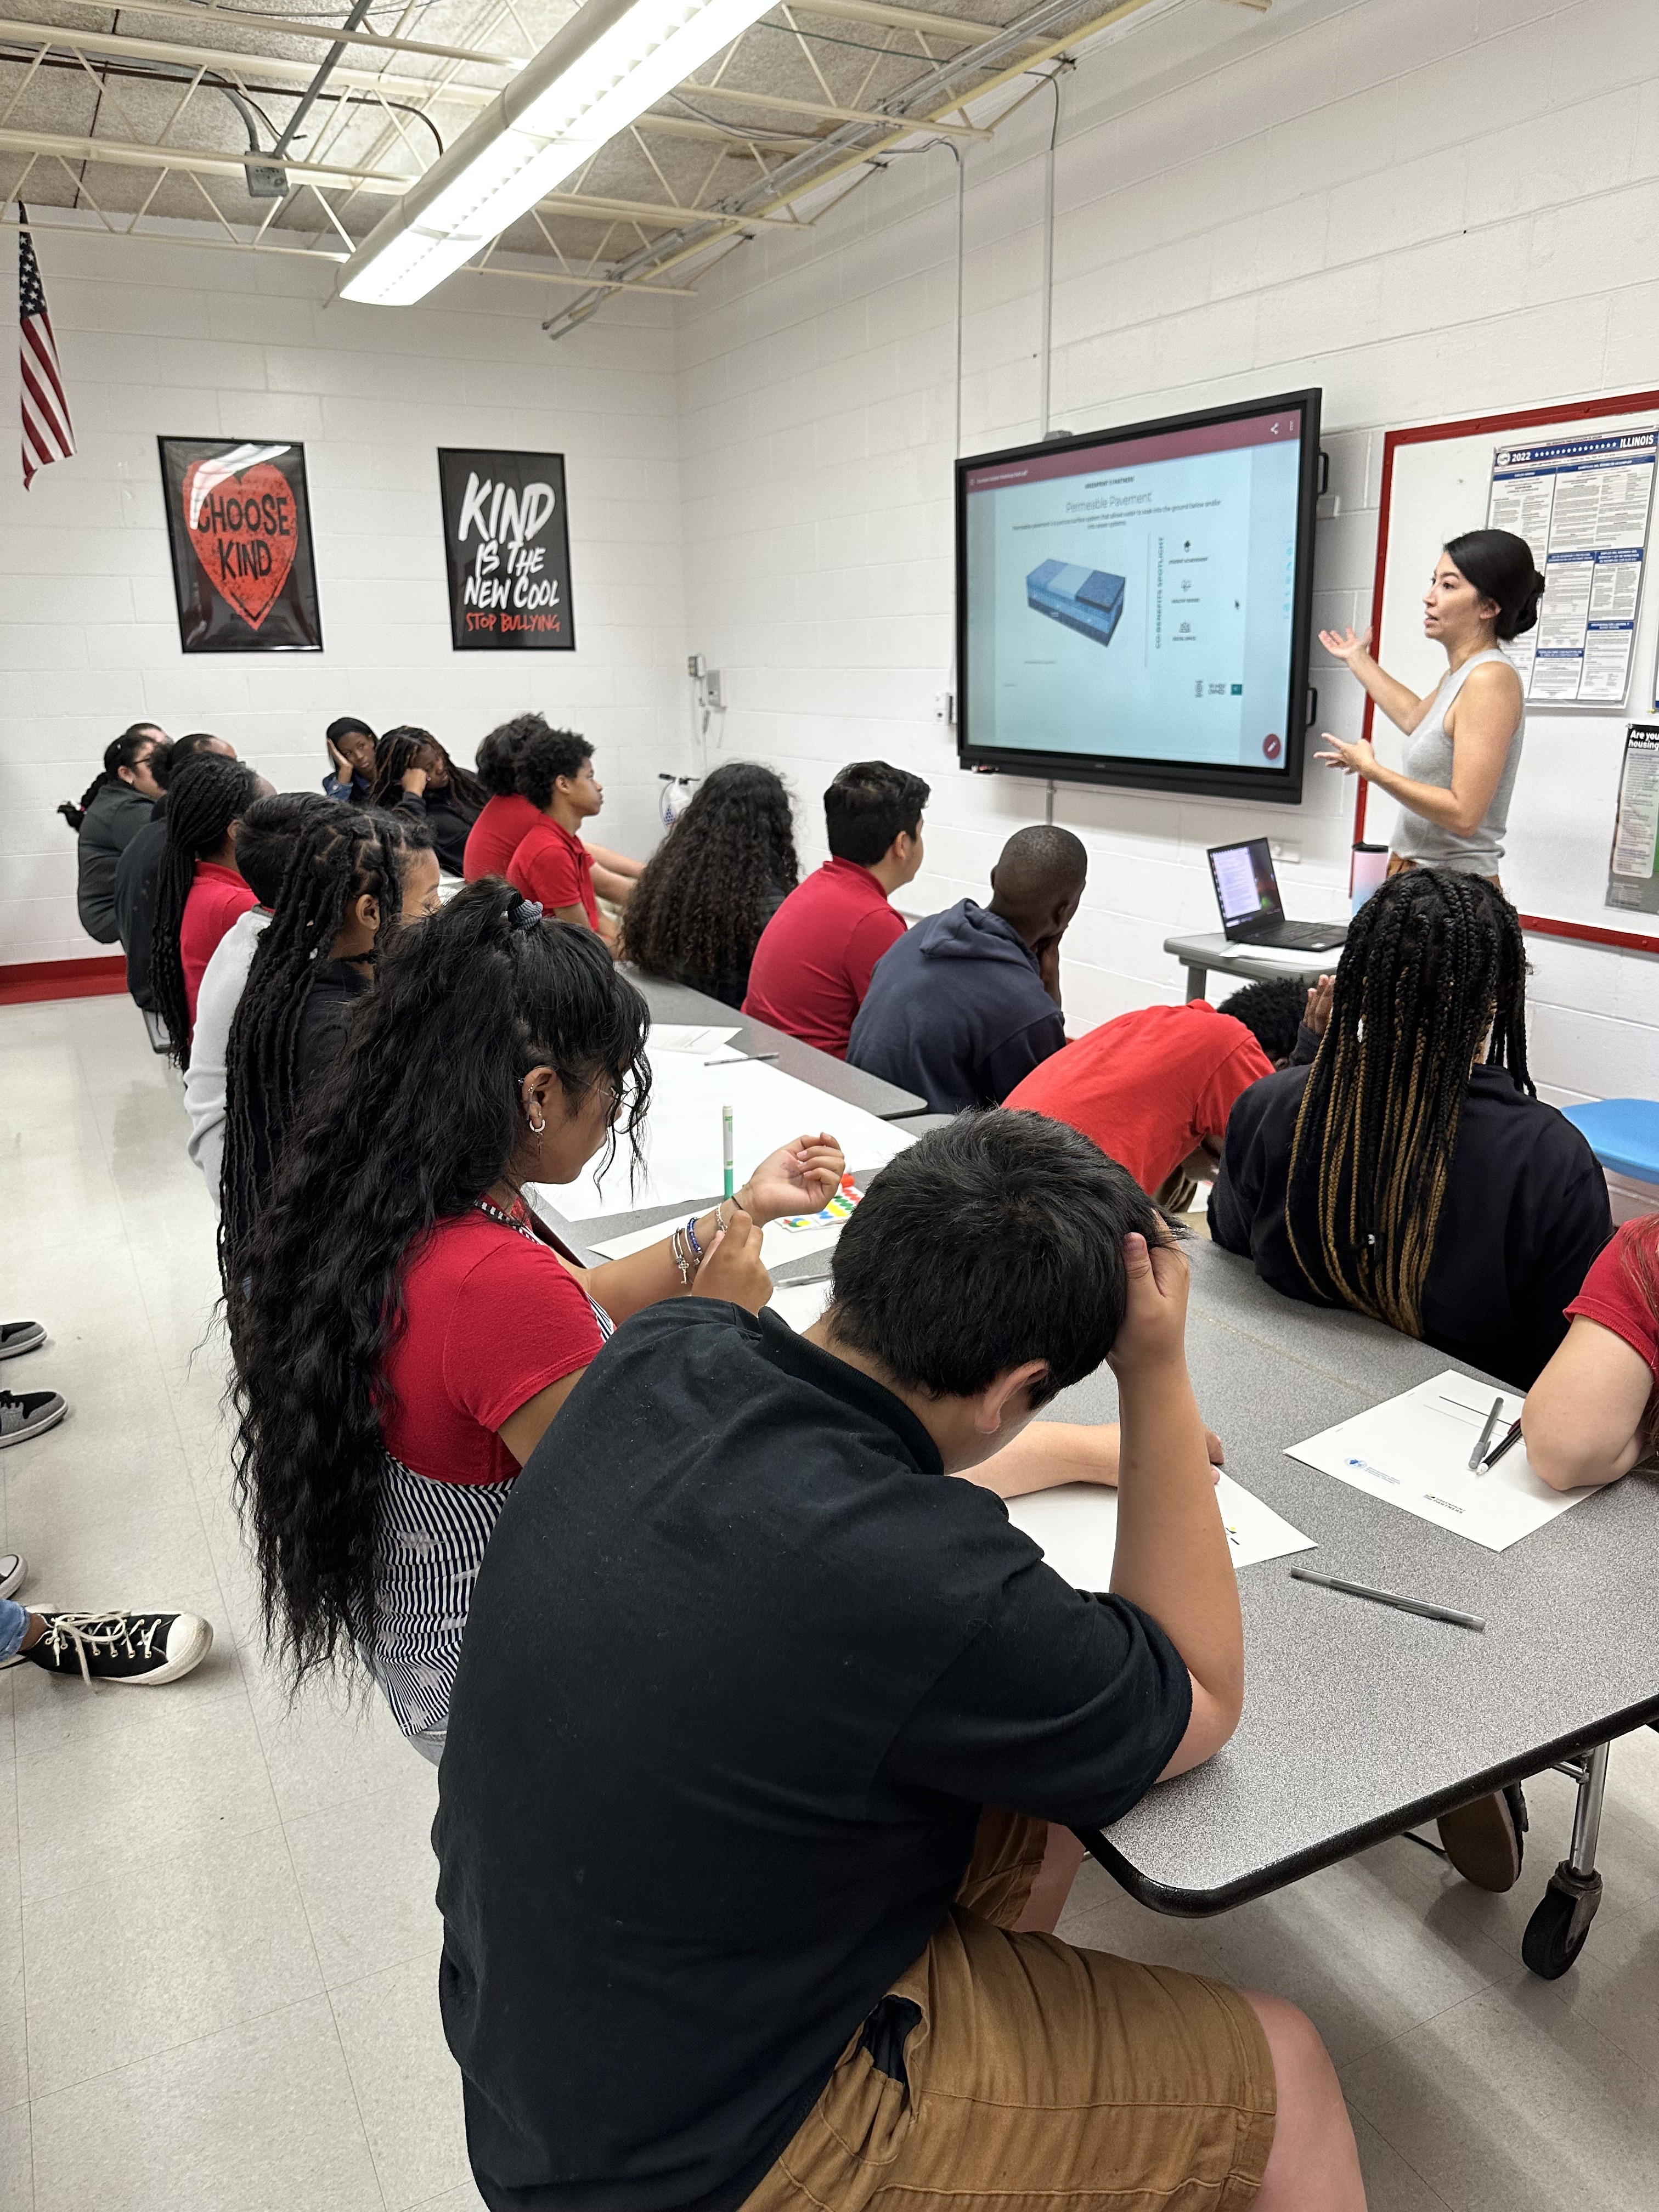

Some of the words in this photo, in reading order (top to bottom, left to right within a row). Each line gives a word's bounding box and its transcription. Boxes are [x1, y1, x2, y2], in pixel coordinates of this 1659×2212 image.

[1511, 452, 1532, 462] 2022
[1620, 435, 1654, 449] ILLINOIS
[198, 493, 290, 536] CHOOSE
[458, 471, 555, 544] KIND
[1066, 498, 1108, 512] Permeable
[1109, 492, 1152, 507] Pavement
[218, 539, 273, 580] KIND
[475, 539, 500, 577] IS
[507, 540, 546, 576] THE
[464, 575, 511, 610] NEW
[513, 575, 560, 610] COOL
[466, 612, 496, 631] STOP
[500, 612, 560, 632] BULLYING
[1628, 739, 1659, 751] housing
[1630, 730, 1645, 739] Are
[1645, 732, 1659, 741] you
